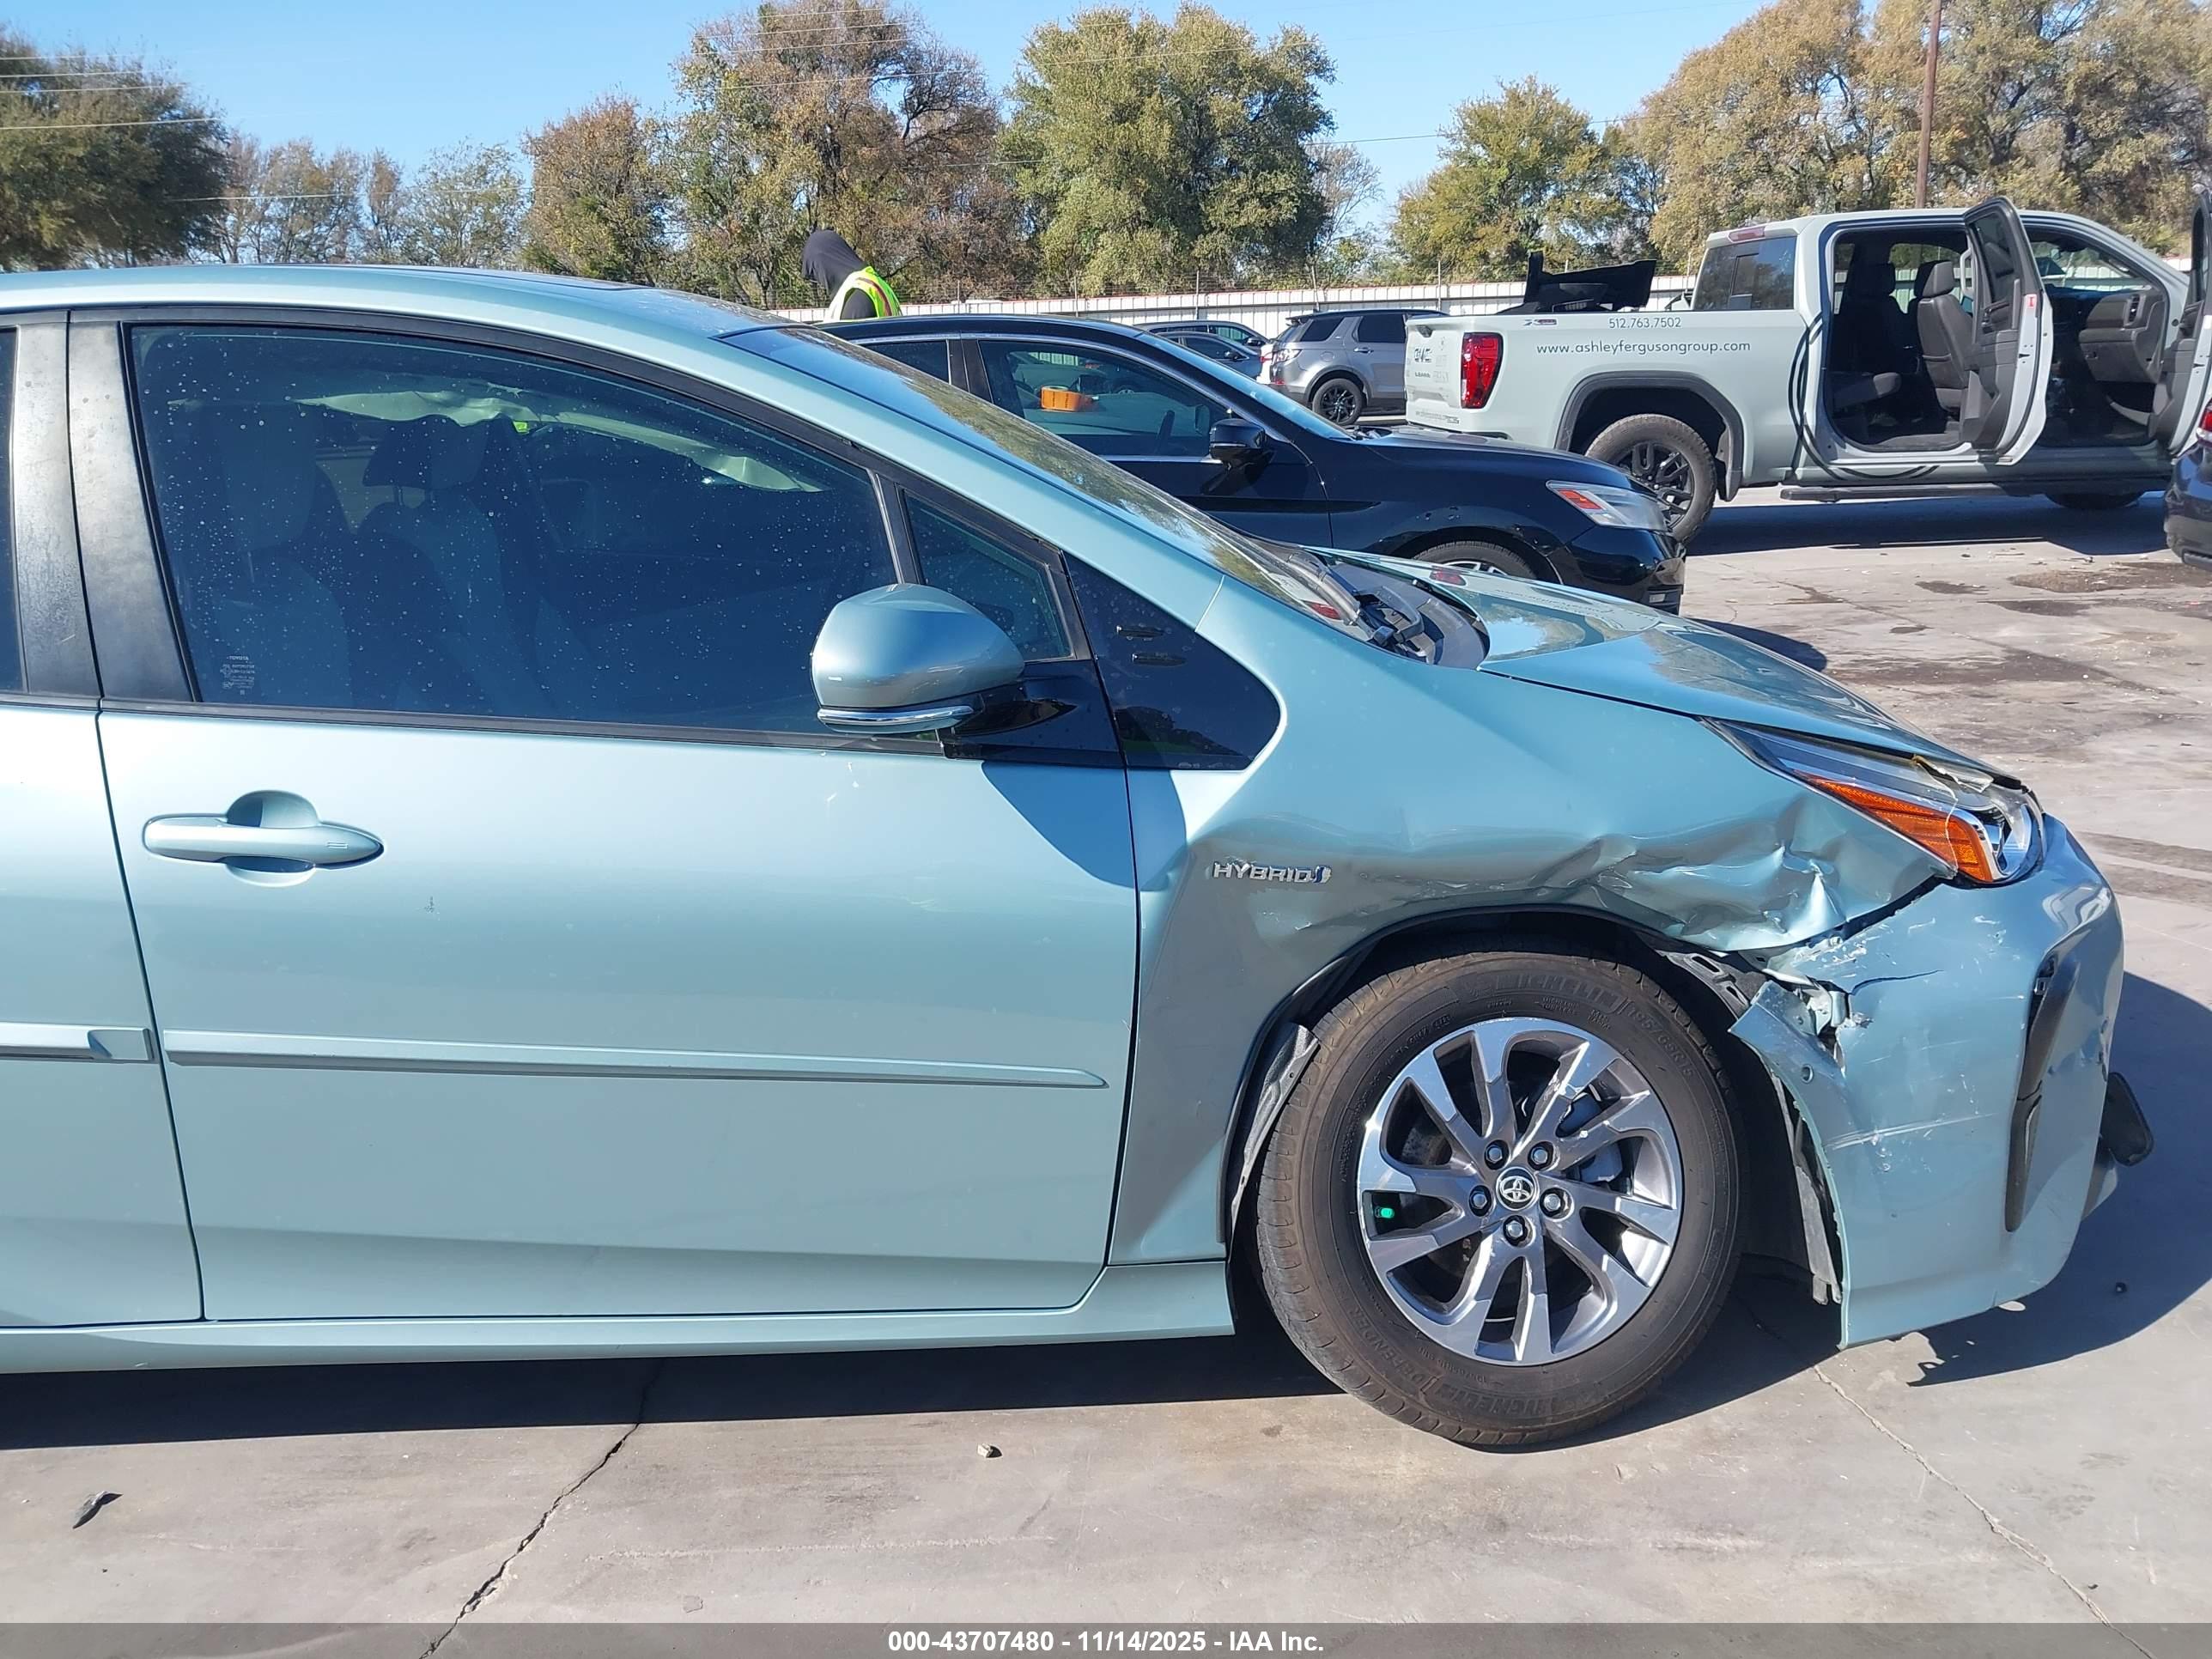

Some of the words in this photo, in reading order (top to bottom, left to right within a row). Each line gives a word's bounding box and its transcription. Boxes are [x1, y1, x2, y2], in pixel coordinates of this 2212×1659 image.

[1608, 317, 1681, 329] 512.763.7502
[1535, 339, 1752, 356] www.ashleyfergusongroup.com
[1212, 860, 1313, 884] HYBRID
